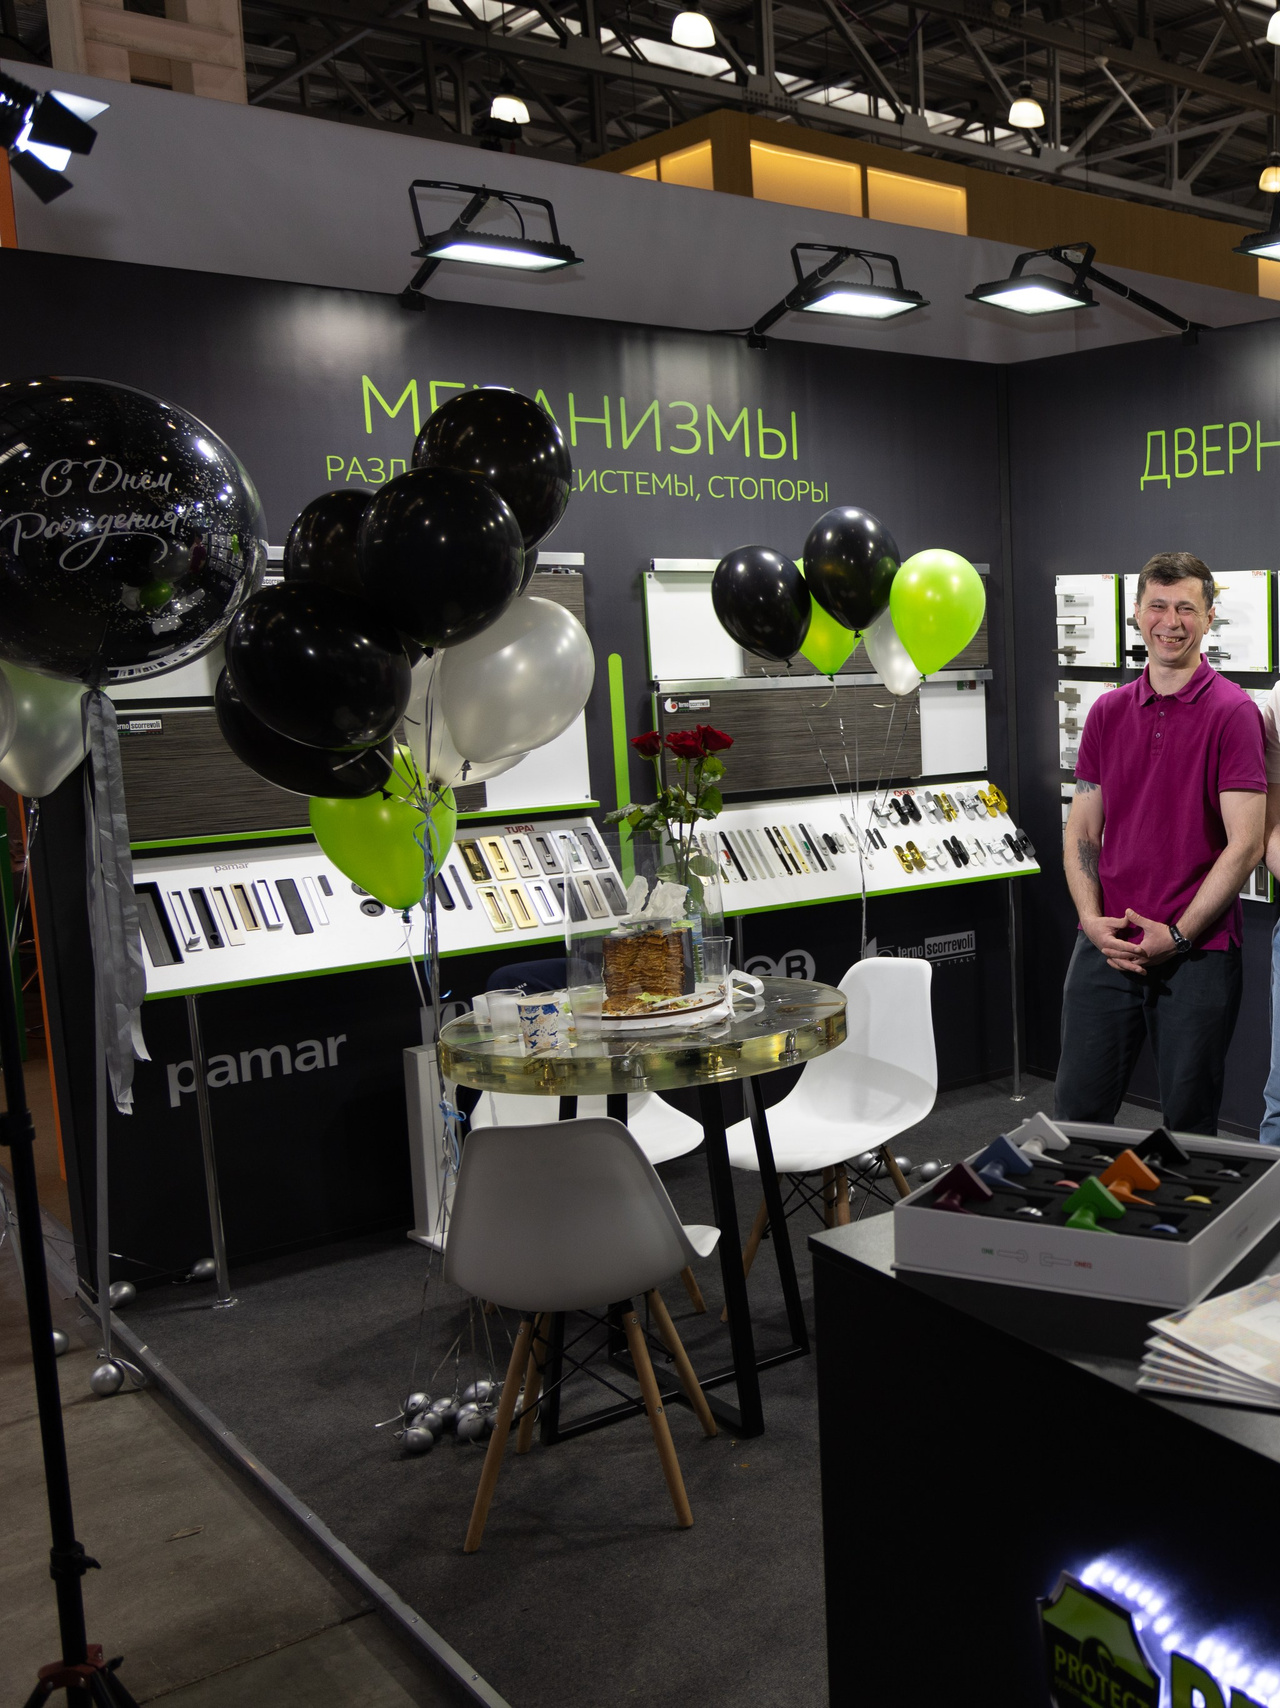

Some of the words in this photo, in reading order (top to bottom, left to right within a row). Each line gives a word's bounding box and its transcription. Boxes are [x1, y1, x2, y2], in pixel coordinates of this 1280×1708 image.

[362, 375, 798, 460] МЕНИЗМЫ
[41, 458, 83, 497] С
[83, 456, 172, 494] Днём
[571, 469, 700, 501] ИСТЕМЫ,
[708, 475, 829, 503] СТОПОРЫ
[504, 825, 535, 834] TUPAI
[214, 862, 249, 873] pamar
[898, 945, 924, 959] terno
[926, 933, 973, 956] scorrevoli
[166, 1034, 347, 1108] pamar
